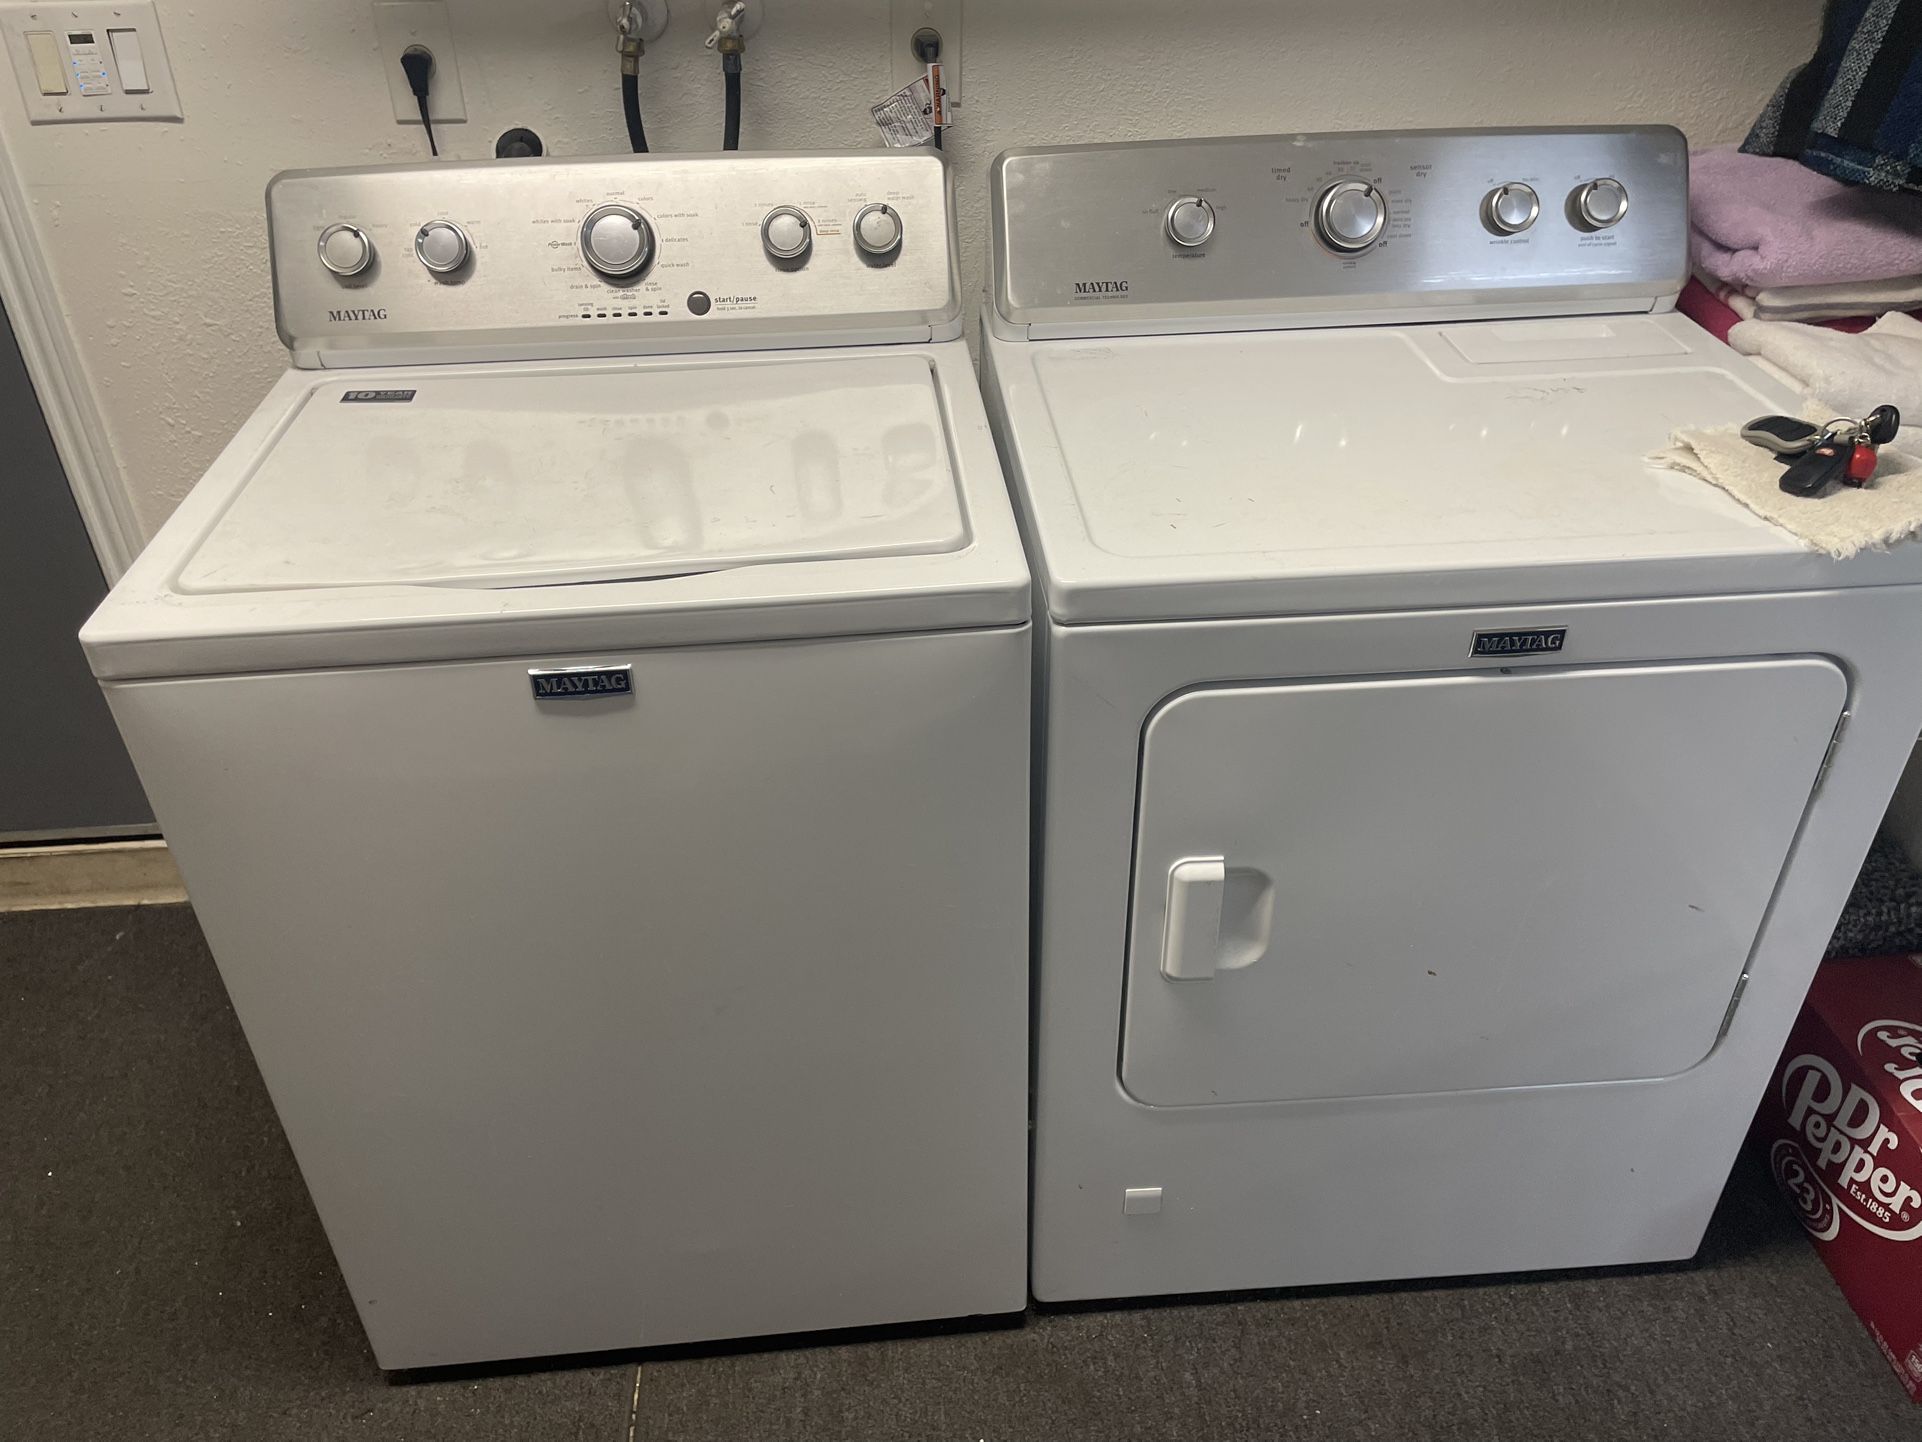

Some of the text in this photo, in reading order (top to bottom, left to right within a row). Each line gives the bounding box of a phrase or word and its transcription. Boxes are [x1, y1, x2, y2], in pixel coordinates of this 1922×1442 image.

[1271, 167, 1291, 175] timed
[1415, 171, 1427, 179] dry
[589, 282, 601, 290] spin
[1074, 280, 1129, 294] MAYTAG
[714, 295, 757, 304] start/pause
[327, 308, 388, 322] MAYTAG
[1477, 634, 1562, 651] MAYTAG
[536, 674, 627, 693] MAYTAG
[1833, 1082, 1899, 1156] Dr
[1782, 1053, 1921, 1215] Pepper
[1787, 1164, 1815, 1211] 23
